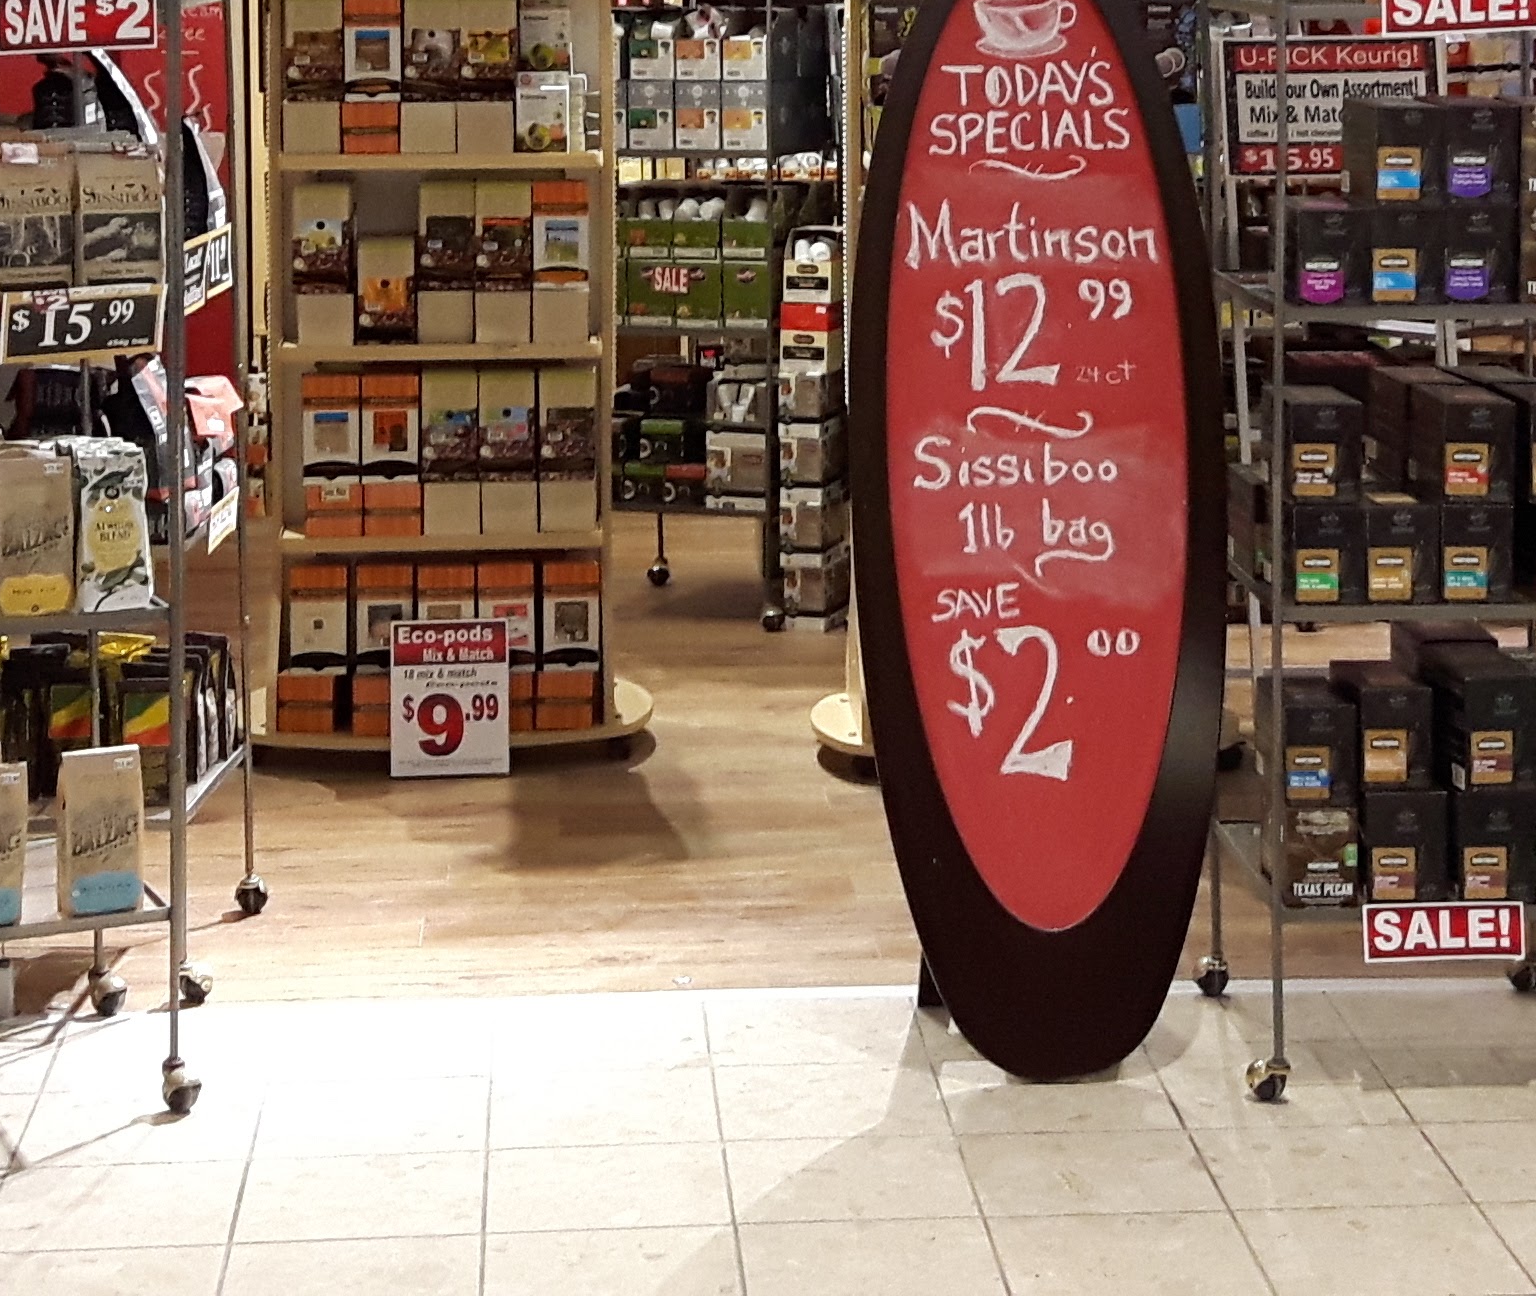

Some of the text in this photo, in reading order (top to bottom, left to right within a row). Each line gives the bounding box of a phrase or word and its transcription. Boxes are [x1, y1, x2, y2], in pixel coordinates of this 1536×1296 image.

[940, 46, 1116, 108] TODAY'S
[1245, 75, 1418, 99] Build our Own Assortment!
[928, 107, 1132, 156] SPECIALS
[1286, 104, 1299, 123] &
[904, 197, 1159, 271] Martinson
[652, 265, 690, 294] SALE
[11, 298, 135, 348] $15.99
[913, 435, 1119, 492] Sissiboo
[1036, 497, 1116, 577] bag
[931, 582, 1021, 624] SAVE
[396, 625, 494, 648] Eco-pods
[421, 646, 495, 663] Mix & Match
[401, 692, 499, 757] $9.99
[1292, 882, 1322, 897] TEXAS
[1373, 908, 1512, 953] SALE!
